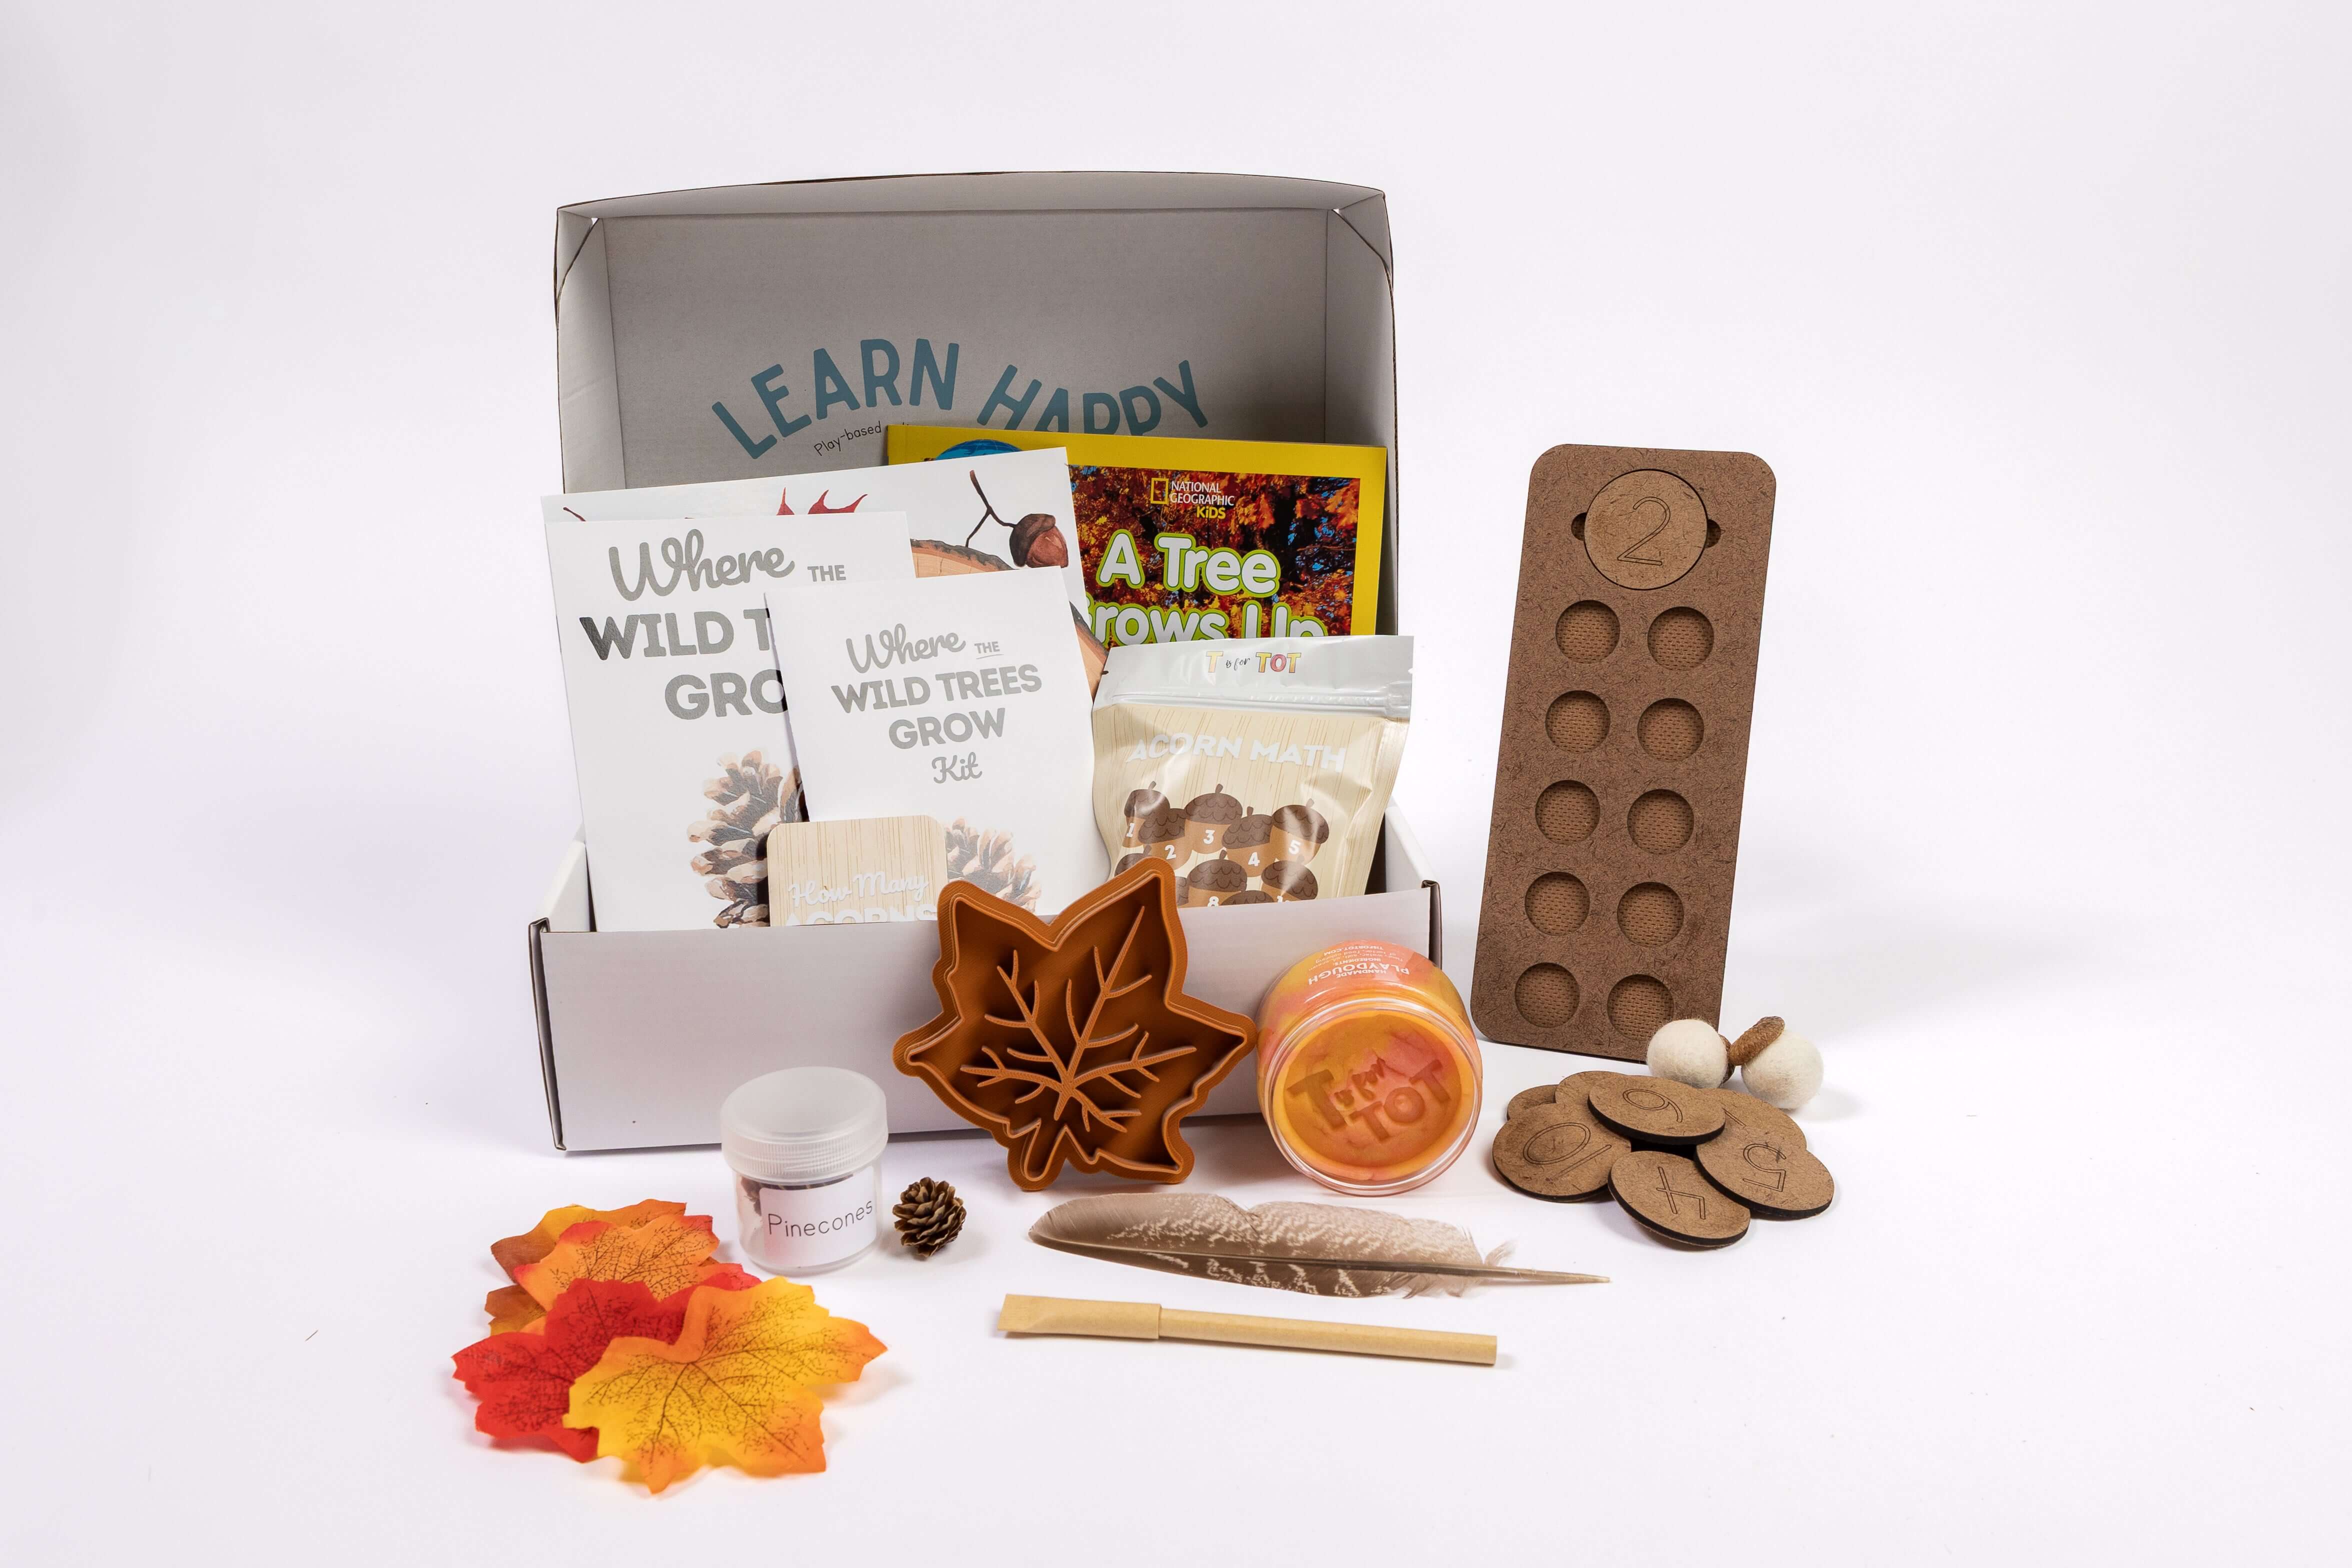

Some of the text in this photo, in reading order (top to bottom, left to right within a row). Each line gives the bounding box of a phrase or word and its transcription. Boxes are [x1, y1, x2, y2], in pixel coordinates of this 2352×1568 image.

[712, 338, 1208, 459] LEARN HAPPY
[814, 420, 882, 456] Play-based
[1170, 492, 1235, 506] GEOGRAPHIC
[1172, 480, 1222, 493] NATIONAL
[1617, 496, 1671, 566] 2
[608, 528, 846, 600] Where THE
[1096, 530, 1281, 598] A Tree
[580, 611, 734, 660] WILD
[1086, 595, 1230, 646] rows
[846, 623, 1000, 674] Where THE
[1206, 651, 1224, 673] T
[1256, 652, 1302, 673] TOT
[664, 669, 788, 720] GRO
[831, 664, 1042, 714] WILD TREES
[888, 708, 1006, 749] GROW
[932, 752, 982, 784] Kit
[1126, 732, 1348, 772] ACORN MATH
[1126, 822, 1134, 838] 1
[1203, 829, 1215, 845] 3
[1288, 840, 1301, 855] 5
[1164, 844, 1177, 860] 2
[1248, 852, 1260, 867] 4
[788, 871, 928, 908] How Many
[1324, 945, 1384, 956] TISFORTOT.COM
[1308, 962, 1410, 984] PLAYDOUGH
[1336, 968, 1388, 978] HANDMADE
[1287, 1069, 1348, 1130] T
[1348, 1059, 1451, 1144] TOT
[768, 1200, 873, 1238] Pinecones
